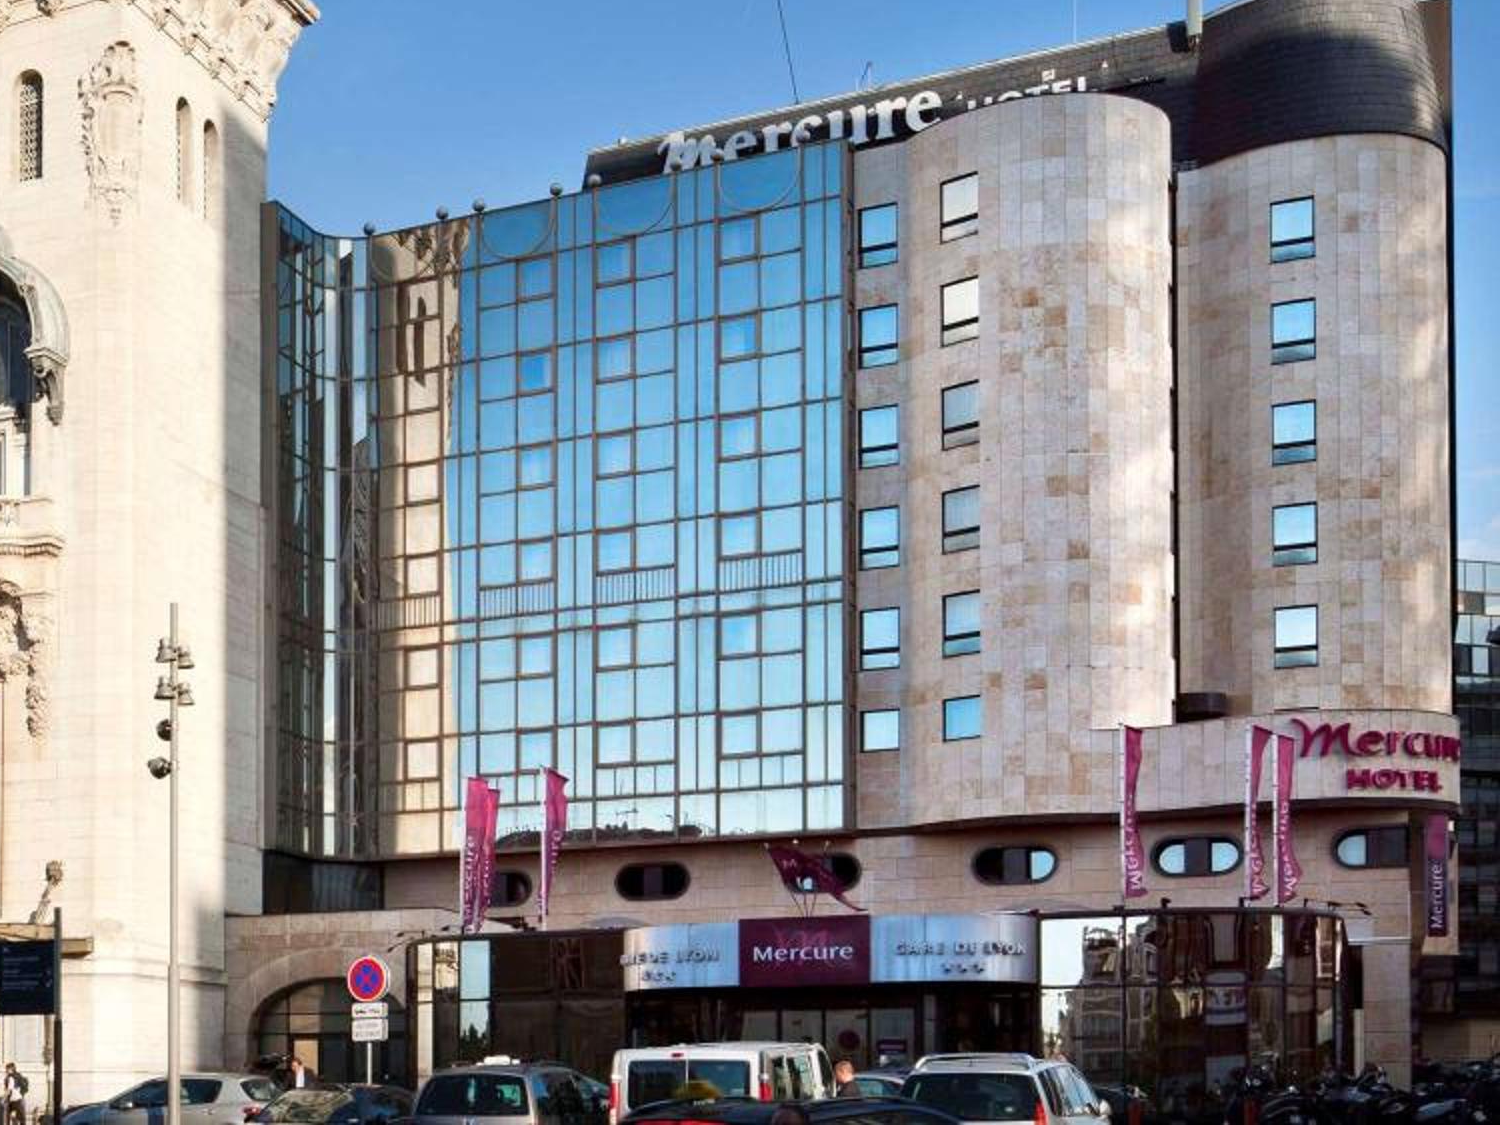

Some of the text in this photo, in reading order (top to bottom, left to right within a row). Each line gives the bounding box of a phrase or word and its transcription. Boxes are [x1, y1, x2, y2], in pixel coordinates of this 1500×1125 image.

[1346, 769, 1443, 792] HOTEL
[1430, 864, 1444, 929] Mercure
[752, 945, 854, 963] Mercure
